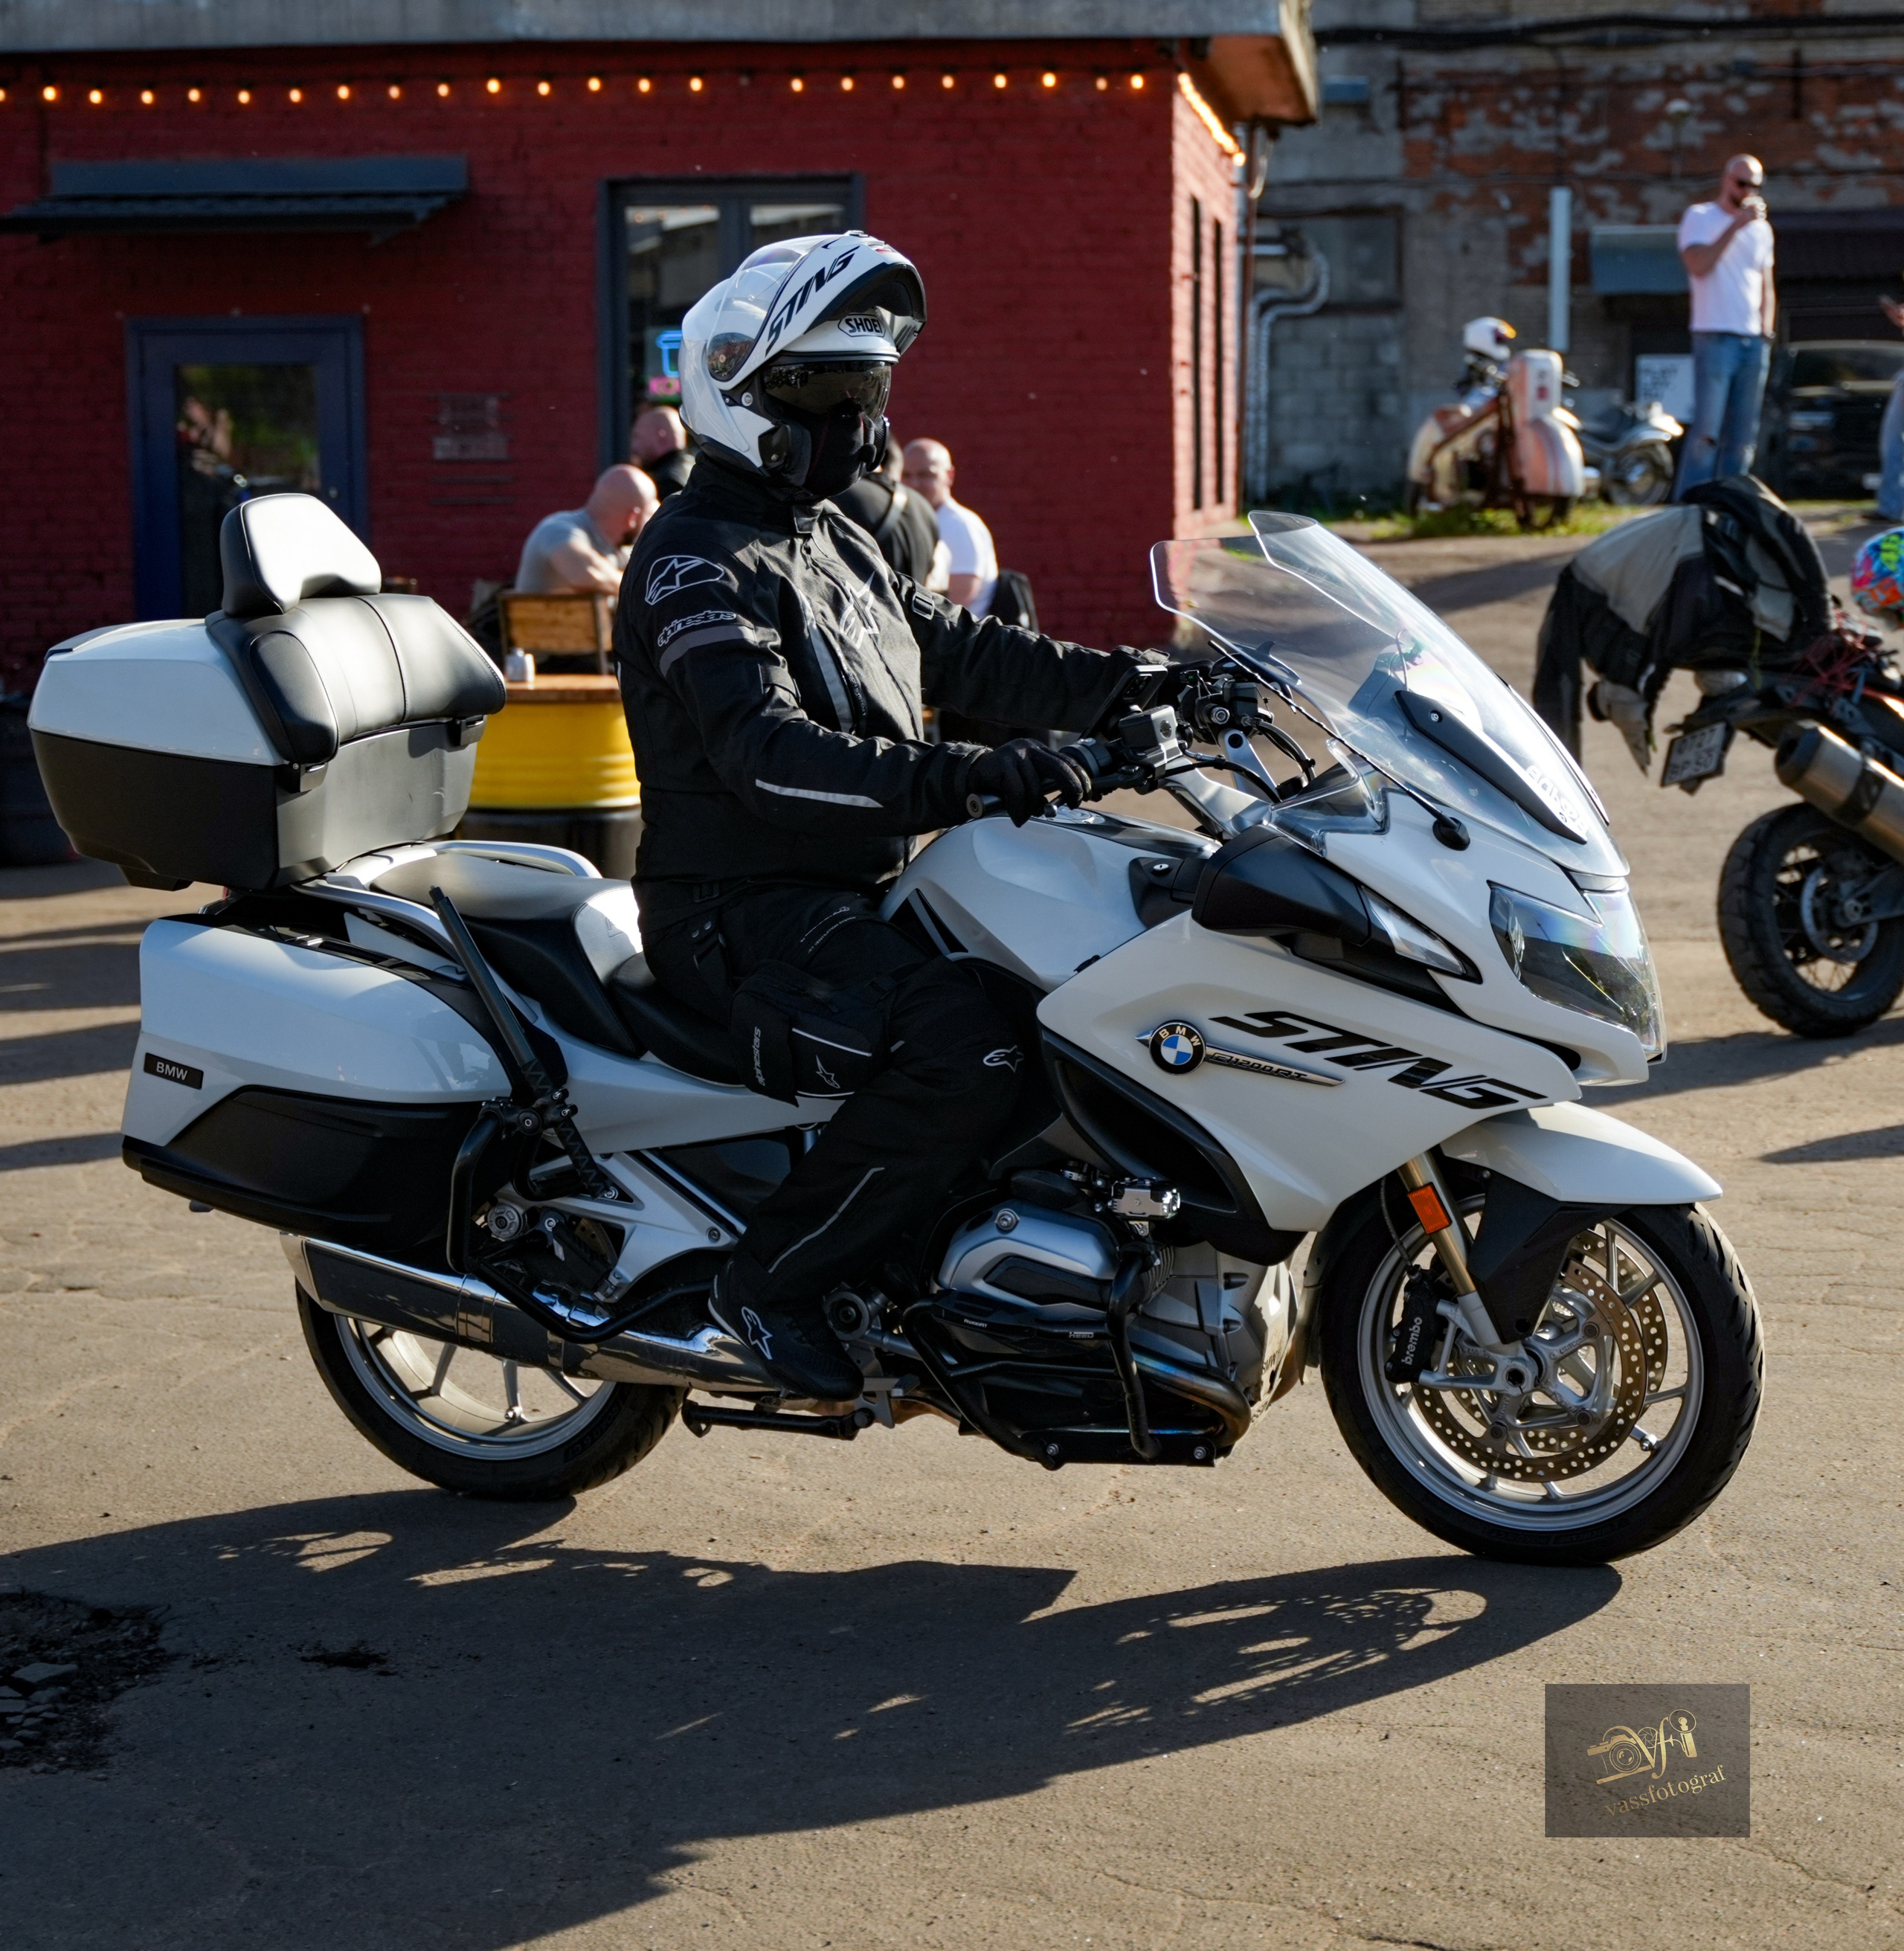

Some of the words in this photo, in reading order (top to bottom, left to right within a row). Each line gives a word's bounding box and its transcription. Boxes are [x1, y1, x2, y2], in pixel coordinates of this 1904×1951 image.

[765, 245, 861, 357] STING
[845, 317, 884, 334] SHOEI
[1159, 1026, 1201, 1047] BMW
[156, 1061, 187, 1081] BMW
[1208, 1011, 1549, 1110] STING
[1401, 1317, 1423, 1366] brembo
